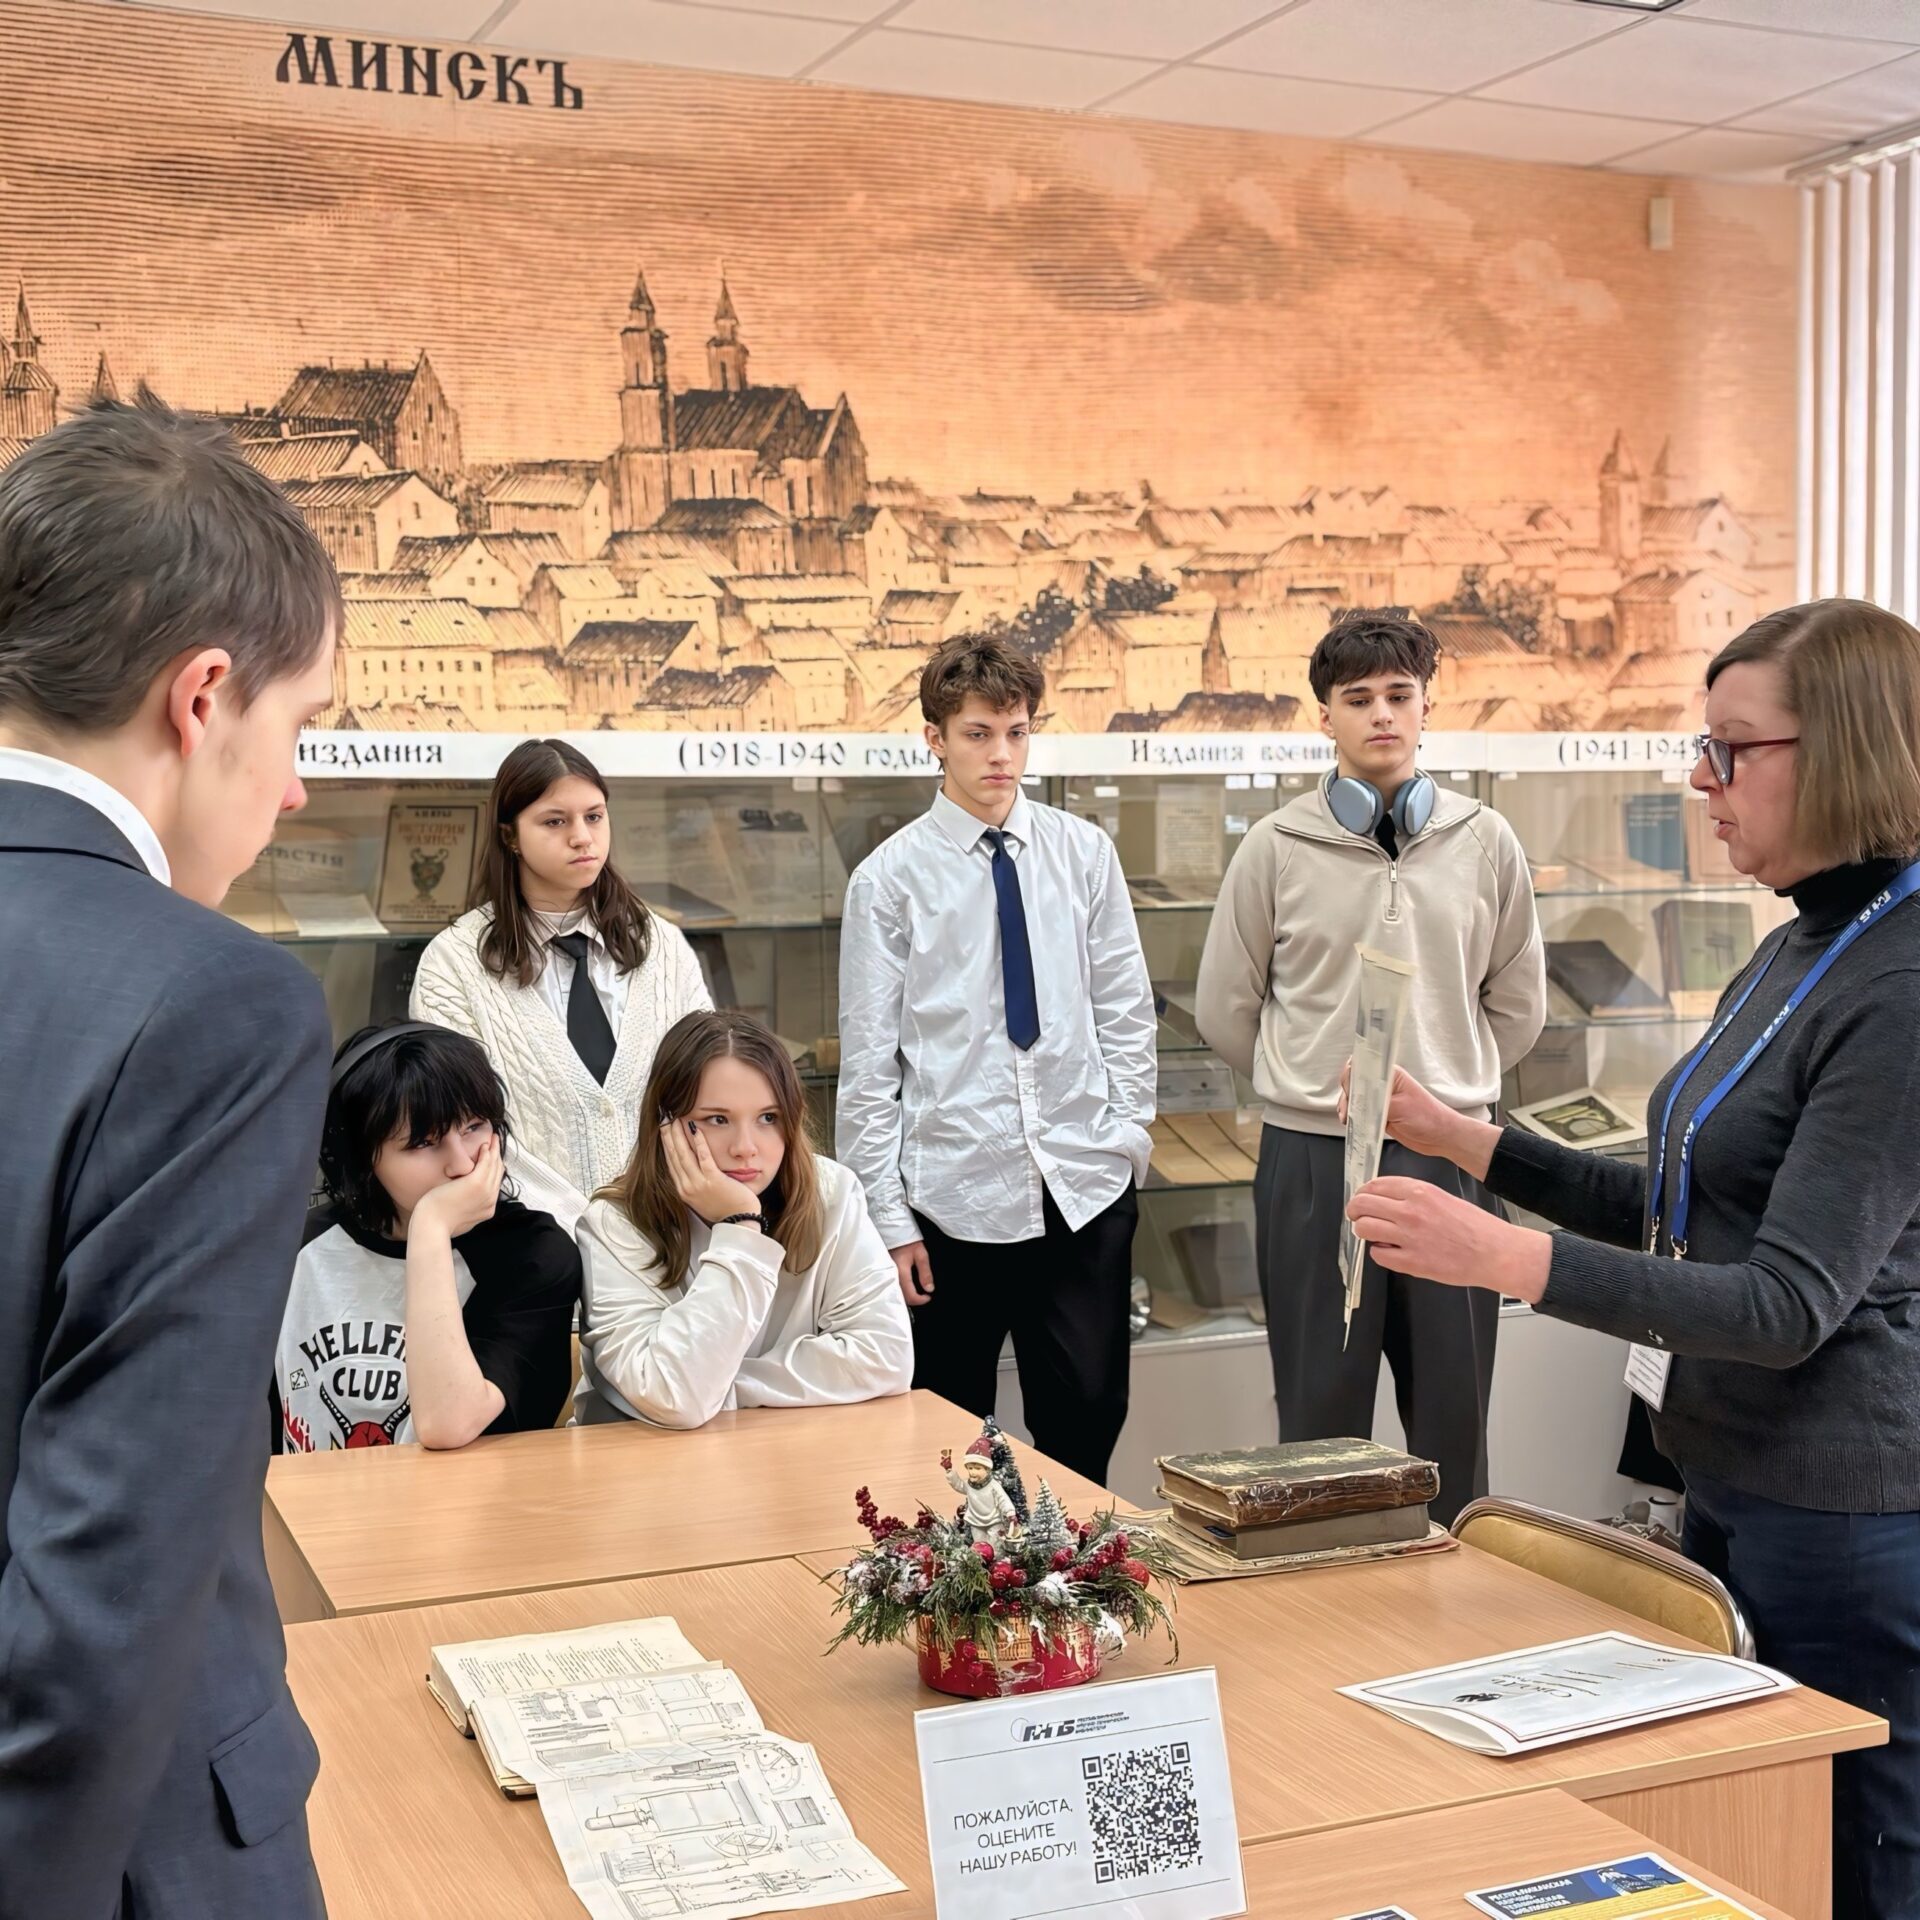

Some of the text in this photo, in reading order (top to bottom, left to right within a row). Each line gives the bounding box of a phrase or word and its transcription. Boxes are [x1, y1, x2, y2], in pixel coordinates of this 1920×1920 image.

[275, 33, 583, 110] МИНСКЪ
[299, 744, 442, 769] издания
[678, 738, 845, 771] (1918-1940
[1131, 738, 1244, 765] Издания
[299, 1321, 406, 1372] HELLFI
[333, 1367, 401, 1401] CLUB
[954, 1798, 1073, 1830] ПОЖАЛУЙСТА,
[977, 1822, 1056, 1848] ОЦЕНИТЕ
[960, 1841, 1077, 1874] НАШУ РАБОТУ!
